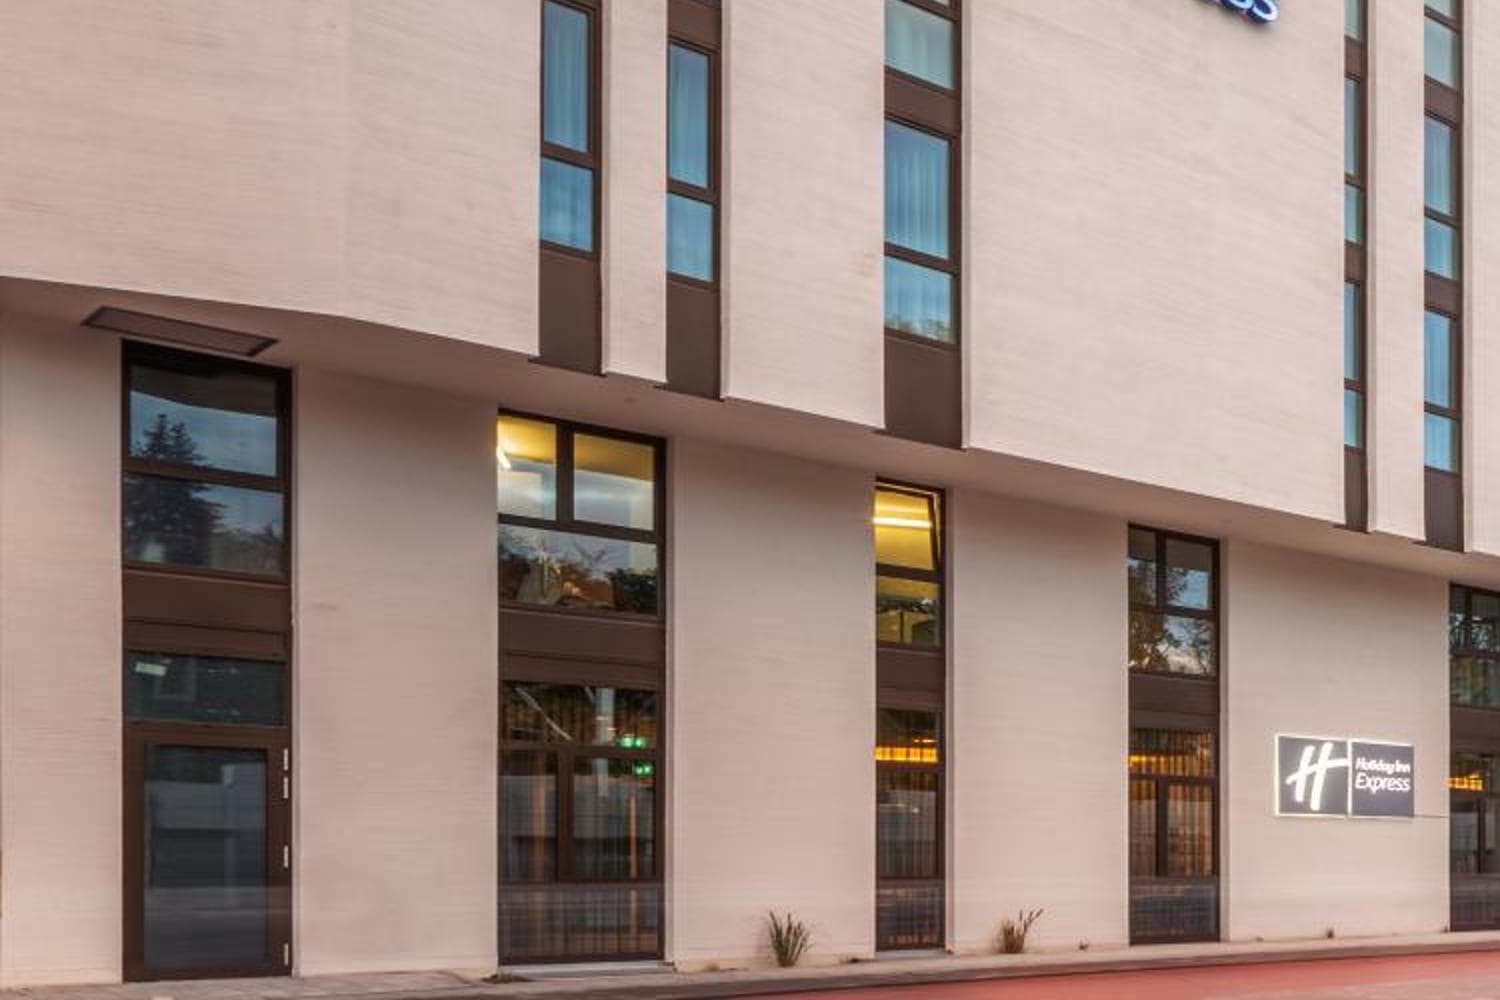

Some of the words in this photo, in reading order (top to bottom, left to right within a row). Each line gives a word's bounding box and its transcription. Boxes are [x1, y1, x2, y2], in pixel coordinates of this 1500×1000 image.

[1355, 757, 1395, 775] Holiday
[1395, 759, 1411, 773] Inn
[1355, 771, 1411, 794] Express
